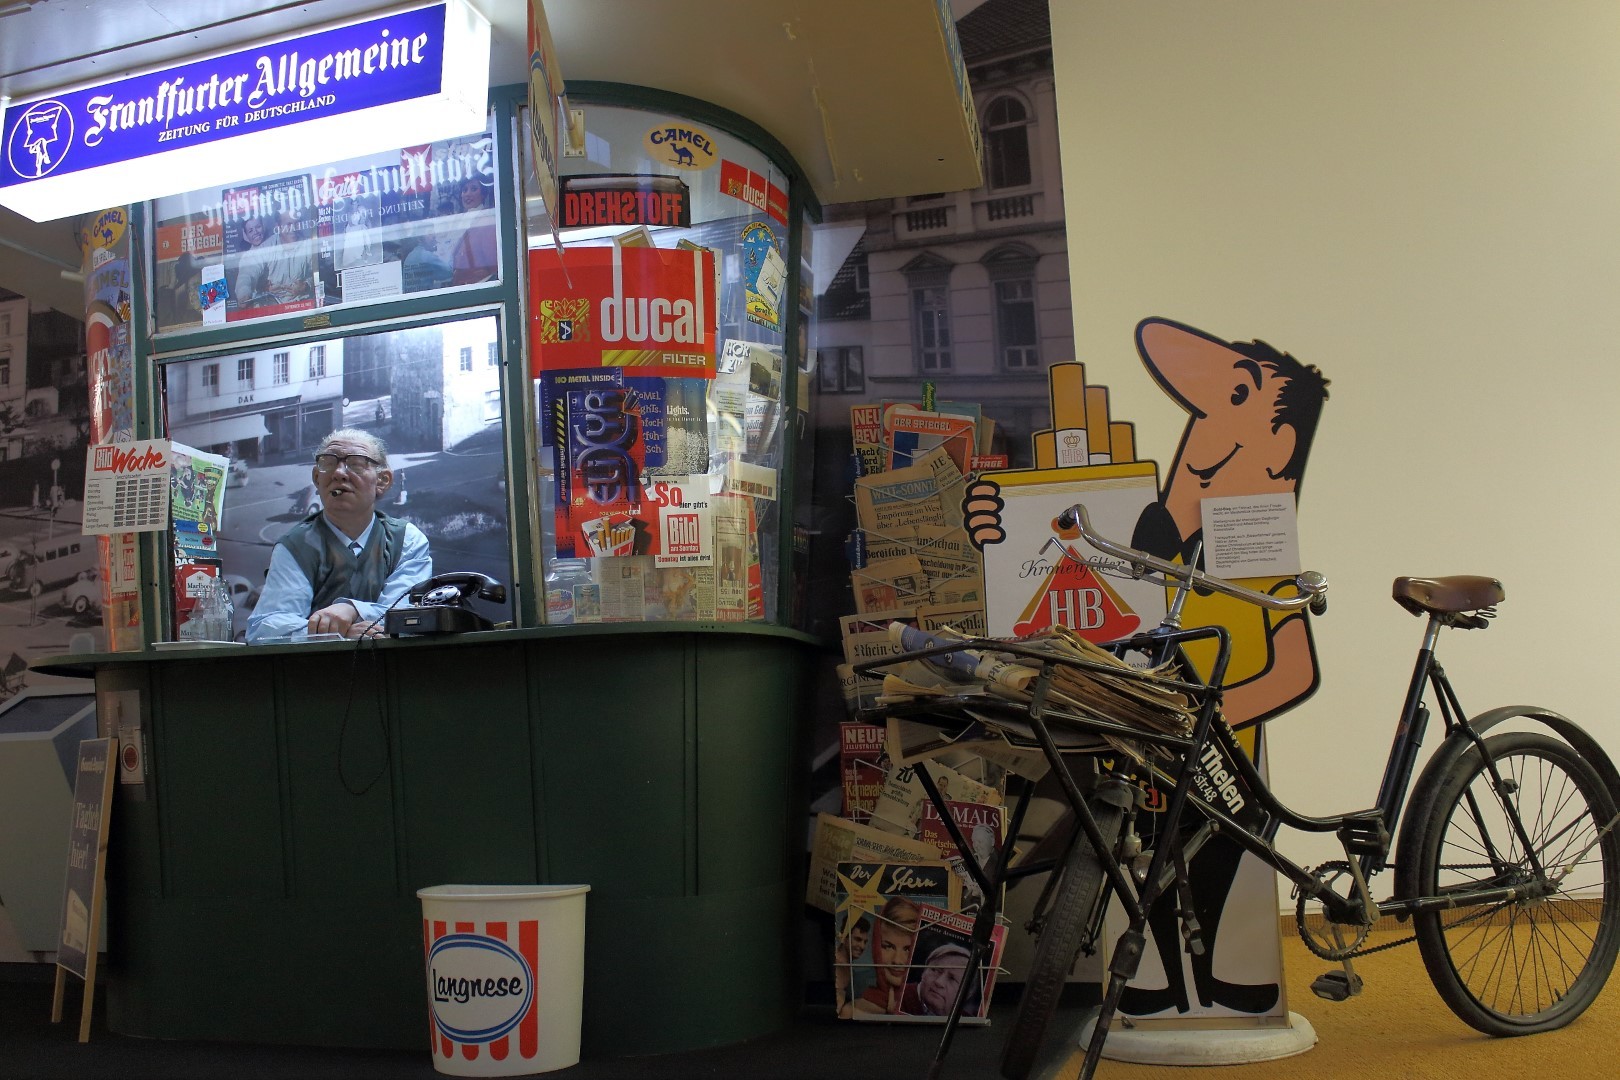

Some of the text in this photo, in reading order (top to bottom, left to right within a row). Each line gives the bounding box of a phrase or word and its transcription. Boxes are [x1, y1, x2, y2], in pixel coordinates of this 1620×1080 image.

[84, 29, 428, 147] Frankfurter Allgemeine
[158, 94, 336, 142] ZEITUNG FÜR DEUTSCHLAND
[650, 128, 713, 156] CAMEL
[743, 168, 768, 211] ducal
[565, 191, 682, 226] DREHSTOFF
[93, 210, 124, 238] CAMEL
[182, 224, 204, 239] DER
[181, 234, 223, 252] SPIEGEL
[100, 270, 128, 288] MEL
[601, 247, 704, 344] ducal
[662, 353, 706, 366] FILTER
[238, 394, 254, 404] DAK
[666, 405, 690, 416] Lights.
[854, 409, 881, 426] NEU
[894, 417, 952, 431] DER SPIEGEL
[96, 444, 166, 474] Bild Woche
[864, 456, 878, 465] ord
[979, 460, 1003, 468] TAGE
[1062, 448, 1084, 464] HB
[655, 482, 682, 508] So
[899, 479, 937, 496] SONNT
[876, 508, 914, 521] Empörung
[668, 516, 698, 545] Bild
[877, 521, 893, 530] über
[917, 536, 960, 551] undschau
[1019, 555, 1128, 579] Kronenfilter
[1048, 587, 1105, 631] HB
[845, 728, 886, 744] NEUE
[1200, 743, 1245, 814] Thelen
[924, 829, 938, 839] Das
[924, 838, 960, 851] Wirtscha
[71, 843, 89, 869] hier!
[850, 864, 938, 894] Der Stern
[922, 908, 974, 931] DER SPIEGE
[433, 968, 523, 1004] Langnese
